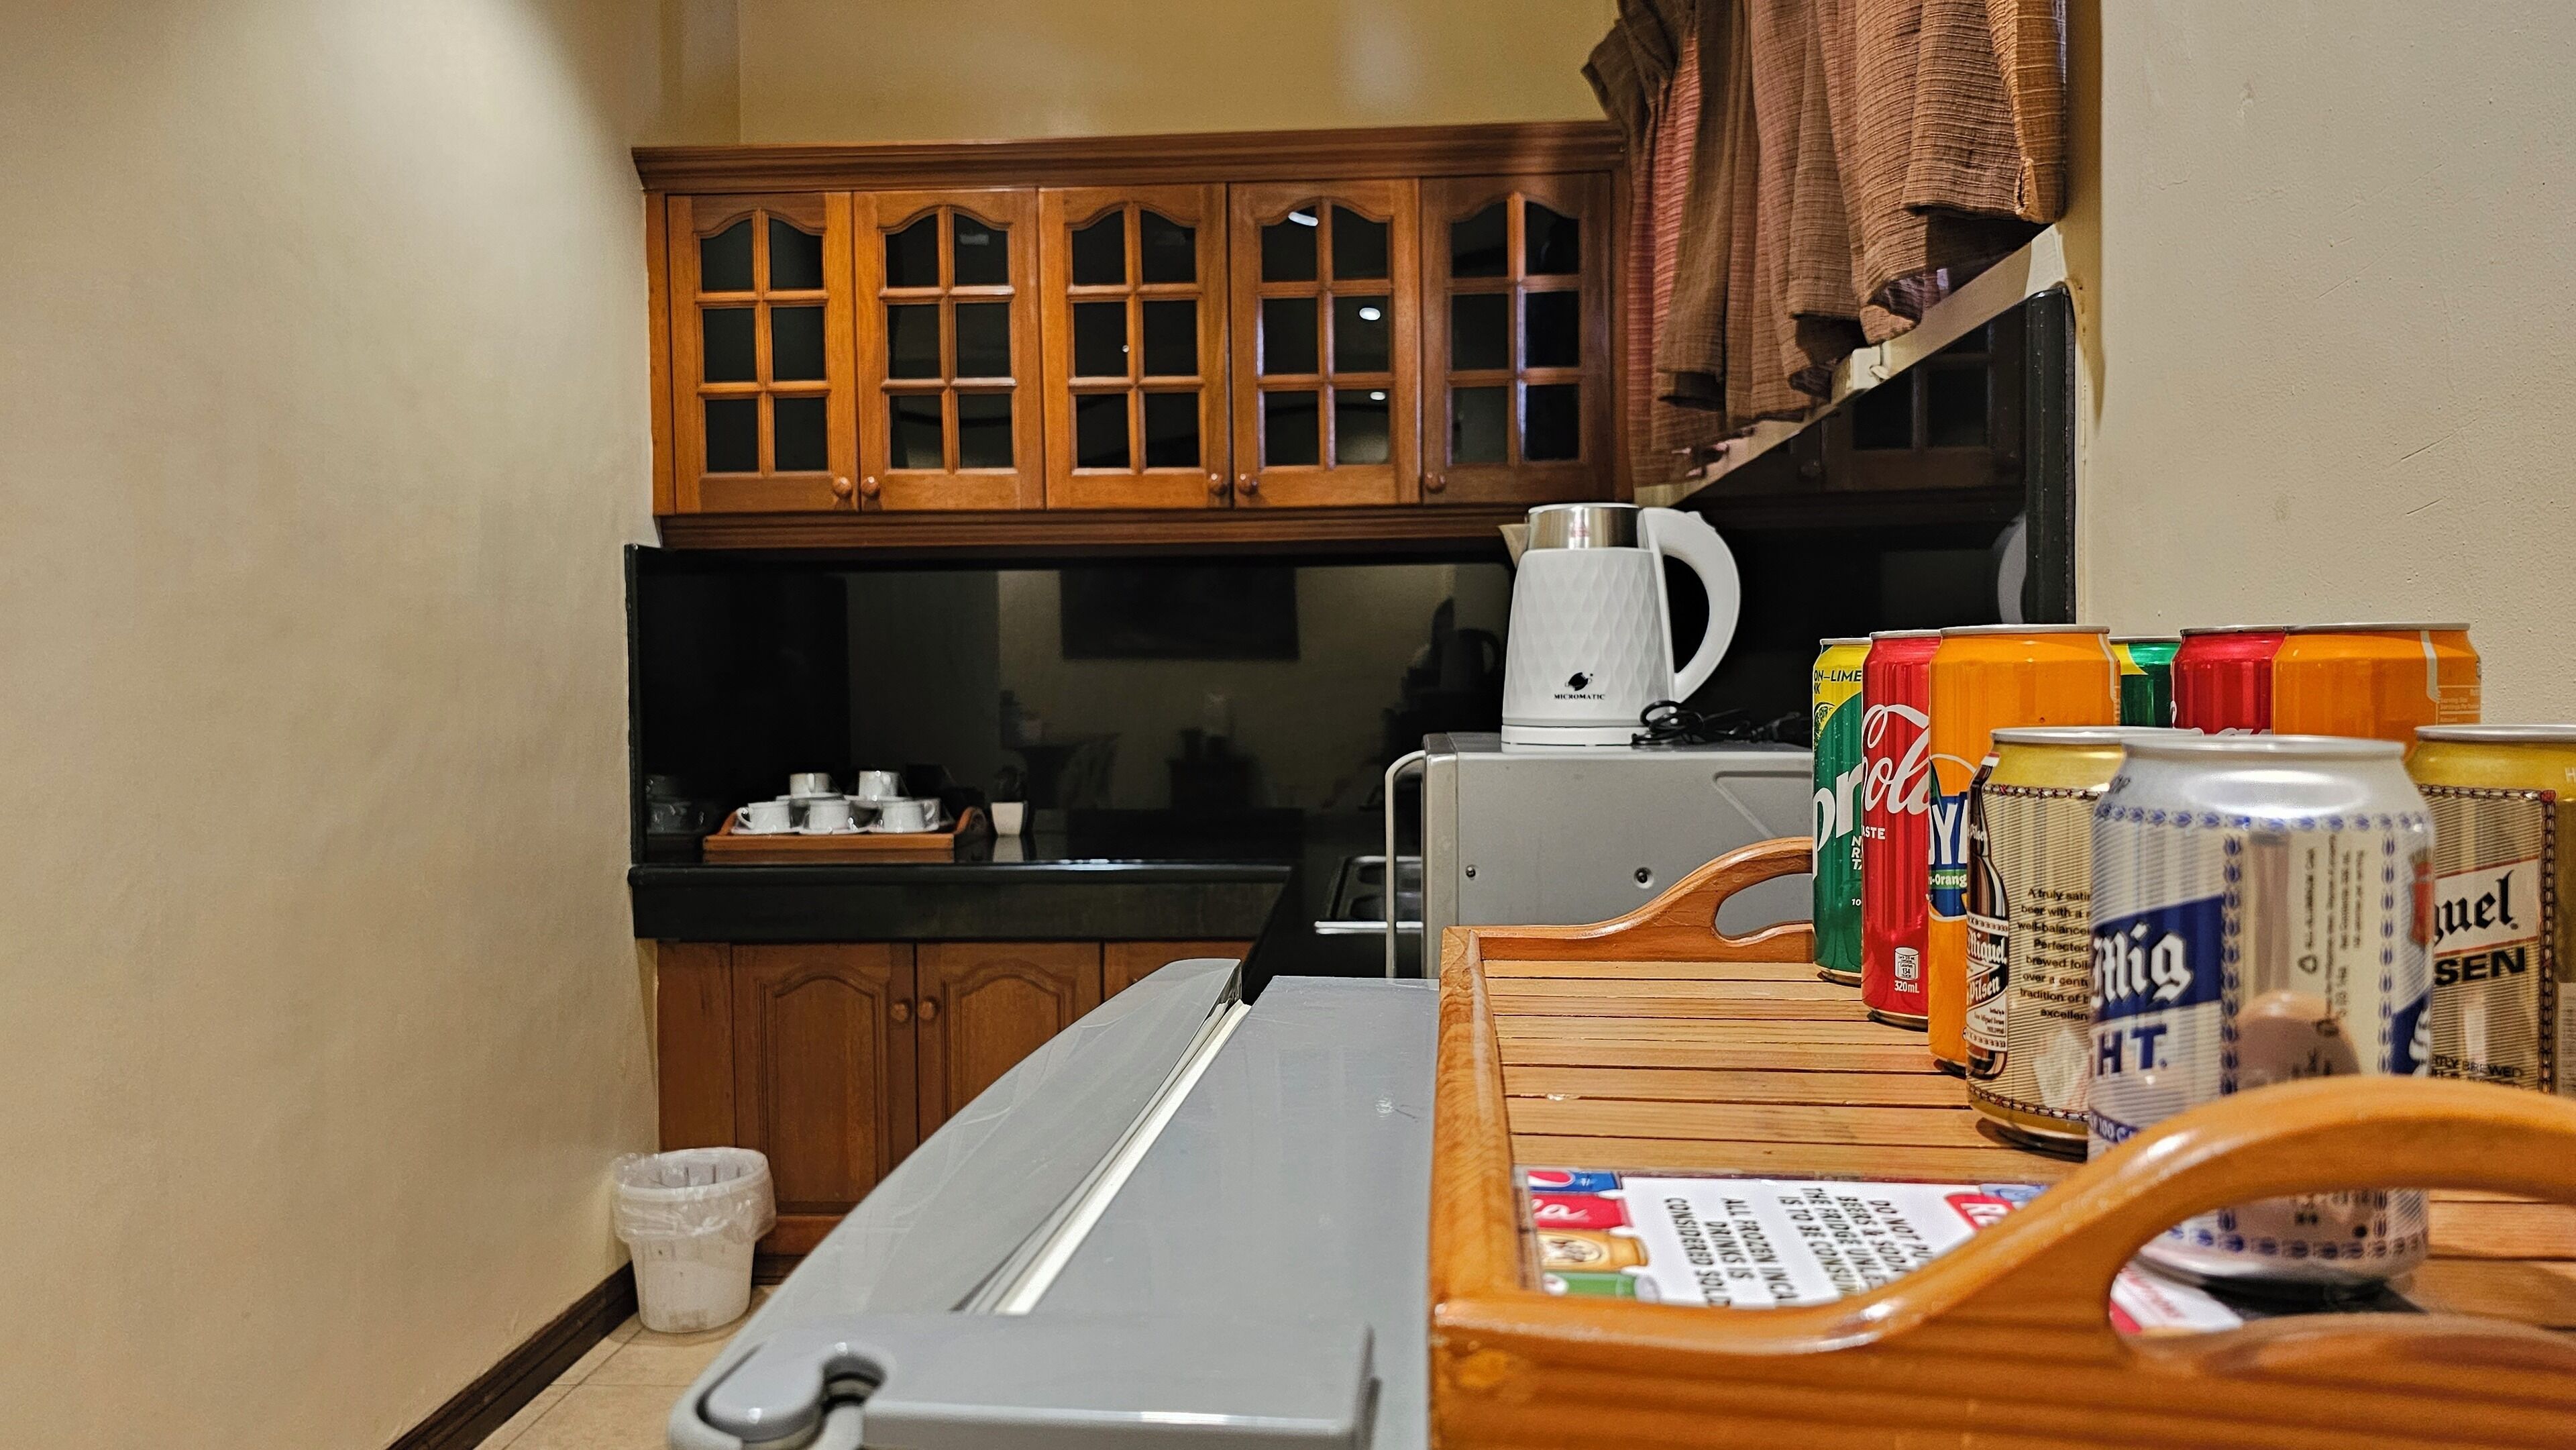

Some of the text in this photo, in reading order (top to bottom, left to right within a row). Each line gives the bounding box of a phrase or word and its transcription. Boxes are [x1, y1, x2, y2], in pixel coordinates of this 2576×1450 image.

[1851, 847, 1862, 859] R
[2027, 888, 2036, 898] A
[2038, 888, 2063, 901] truly
[2021, 906, 2044, 915] beer
[2048, 907, 2071, 917] with
[1967, 927, 2005, 964] Miguel
[2034, 939, 2088, 952] Perfected
[2026, 955, 2066, 968] brewed
[2434, 946, 2526, 986] SEN
[2023, 974, 2046, 983] over
[1967, 976, 2000, 1005] Pilsen
[2020, 987, 2063, 1002] tradition
[2068, 994, 2080, 1002] of
[2462, 1059, 2523, 1078] BREWED
[1778, 1196, 1804, 1206] IS
[1801, 1188, 1832, 1206] THE
[1721, 1198, 1752, 1216] ALL
[1786, 1208, 1814, 1222] TO
[1835, 1196, 1878, 1226] BEERS
[1868, 1200, 1898, 1215] DO
[1664, 1197, 1715, 1266] CONSIDERED
[1798, 1223, 1826, 1239] BE
[1815, 1208, 1863, 1246] FRIDGE
[1881, 1216, 1923, 1241] NOT
[1734, 1219, 1780, 1263] FROZEN
[1704, 1221, 1756, 1280] DRINKS IS
